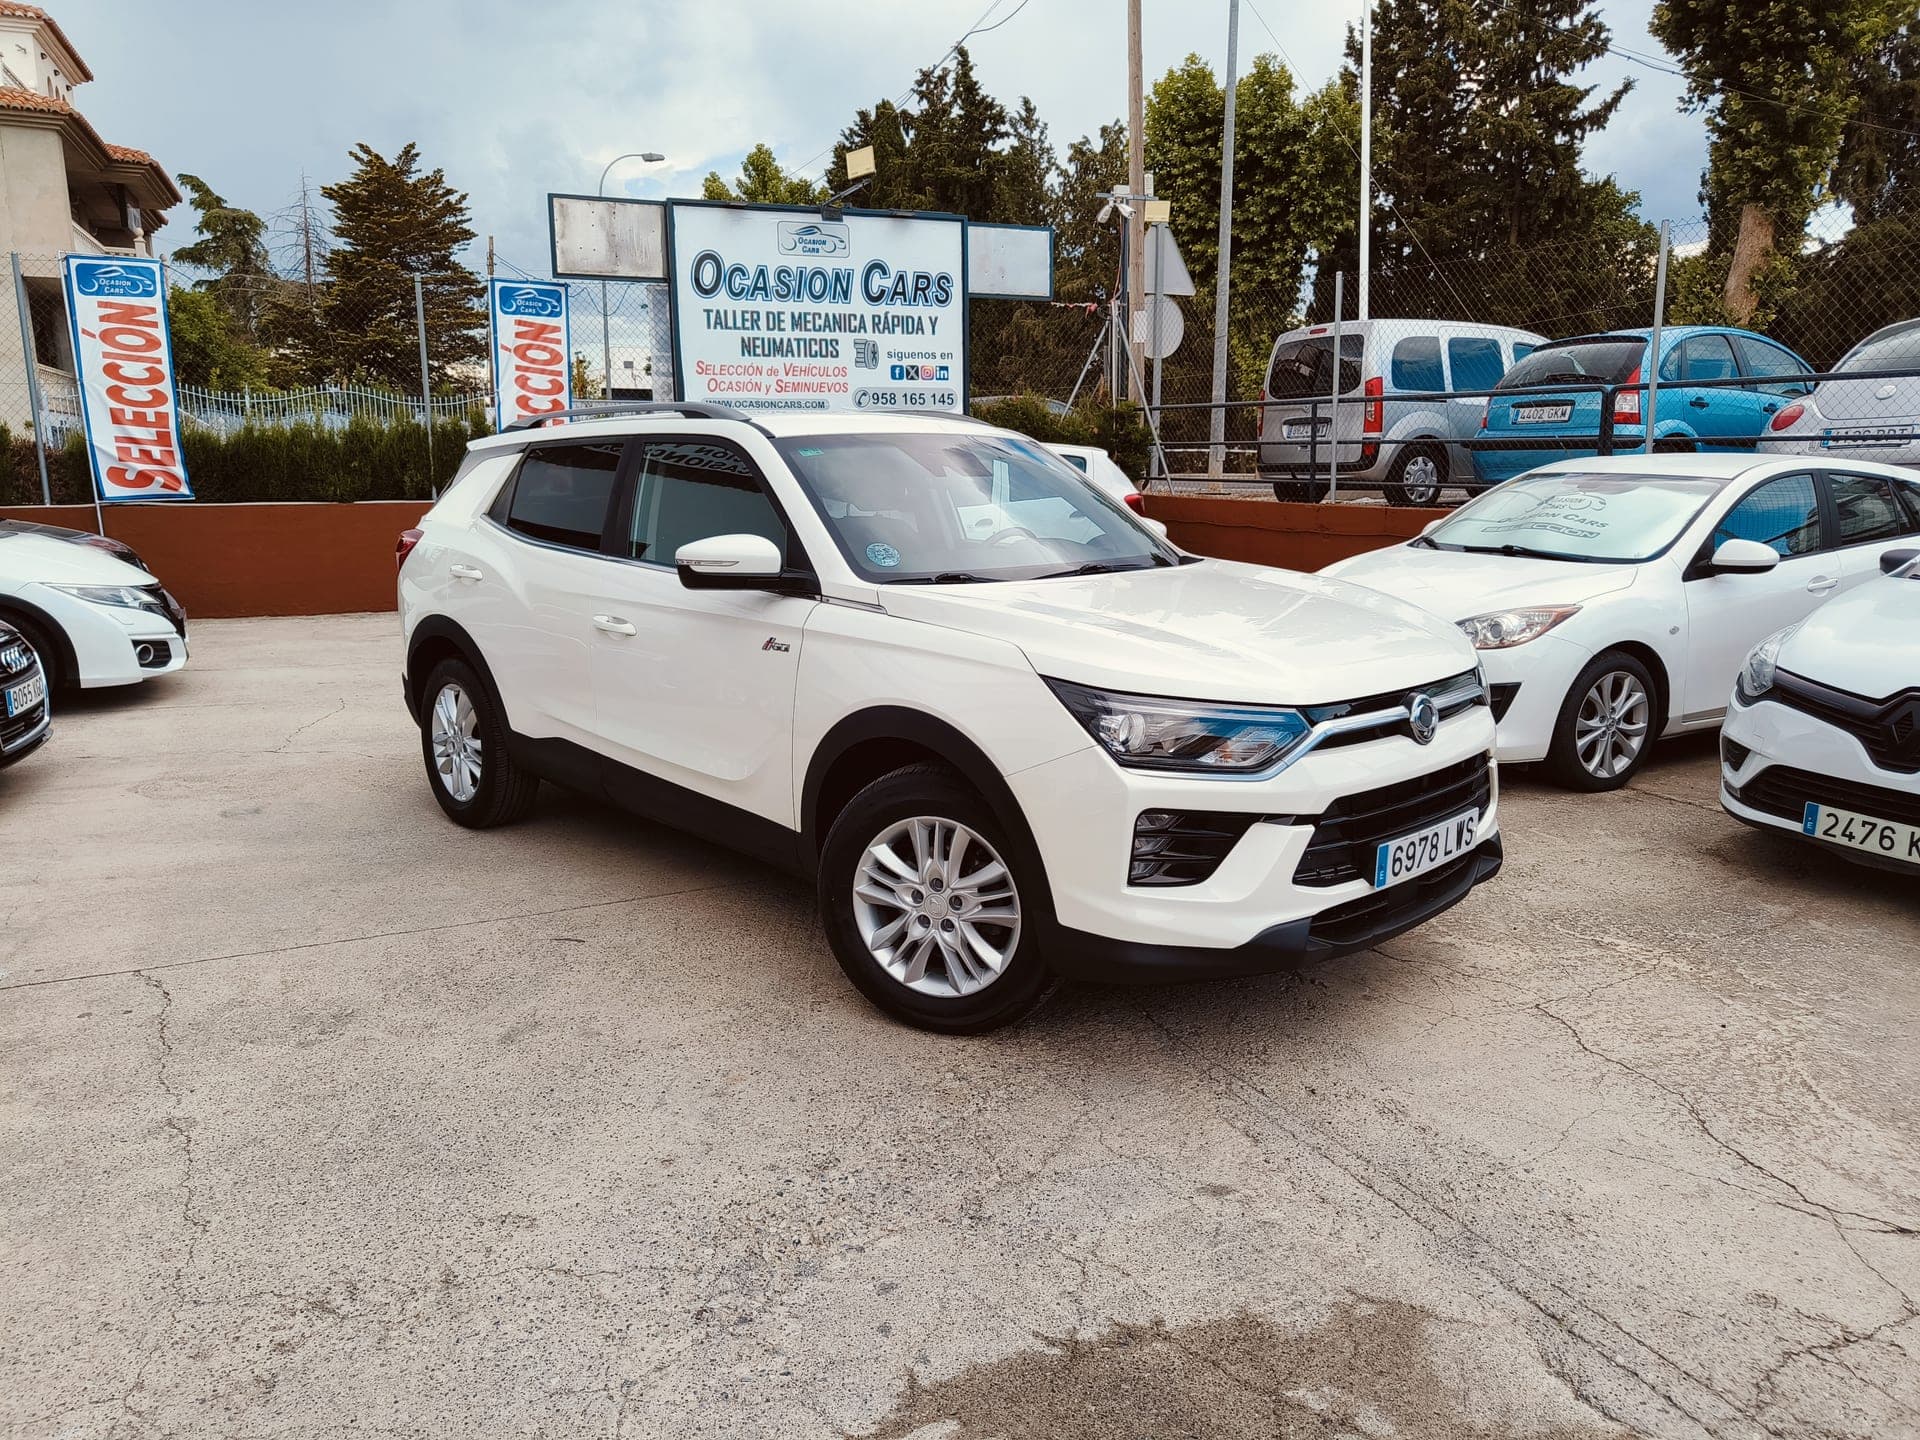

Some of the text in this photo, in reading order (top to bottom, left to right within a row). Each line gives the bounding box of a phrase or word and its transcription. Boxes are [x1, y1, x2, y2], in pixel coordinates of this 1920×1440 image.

[798, 237, 827, 246] OCASION
[802, 246, 820, 254] CARS
[99, 278, 132, 287] OCASION
[691, 250, 954, 307] OCASION CARS
[104, 286, 125, 295] CARS
[516, 299, 543, 307] OCASION
[520, 306, 536, 314] CARS
[703, 309, 939, 335] TALLER DE MECANICA RÁPIDA Y
[741, 336, 840, 358] NEUMATICOS
[940, 351, 954, 361] en
[696, 360, 848, 377] SELECCIÓN de VEHÍCULOS
[707, 377, 849, 395] OCASIÓN y SEMINUEVOS
[81, 300, 182, 491] SELECCIÓN
[872, 392, 954, 406] 958 165 145
[1520, 408, 1544, 420] 4402
[13, 684, 34, 710] 8055
[1822, 812, 1897, 851] 2476
[1907, 831, 1920, 858] K
[1391, 831, 1439, 877] 6978
[1444, 816, 1475, 856] LWS
